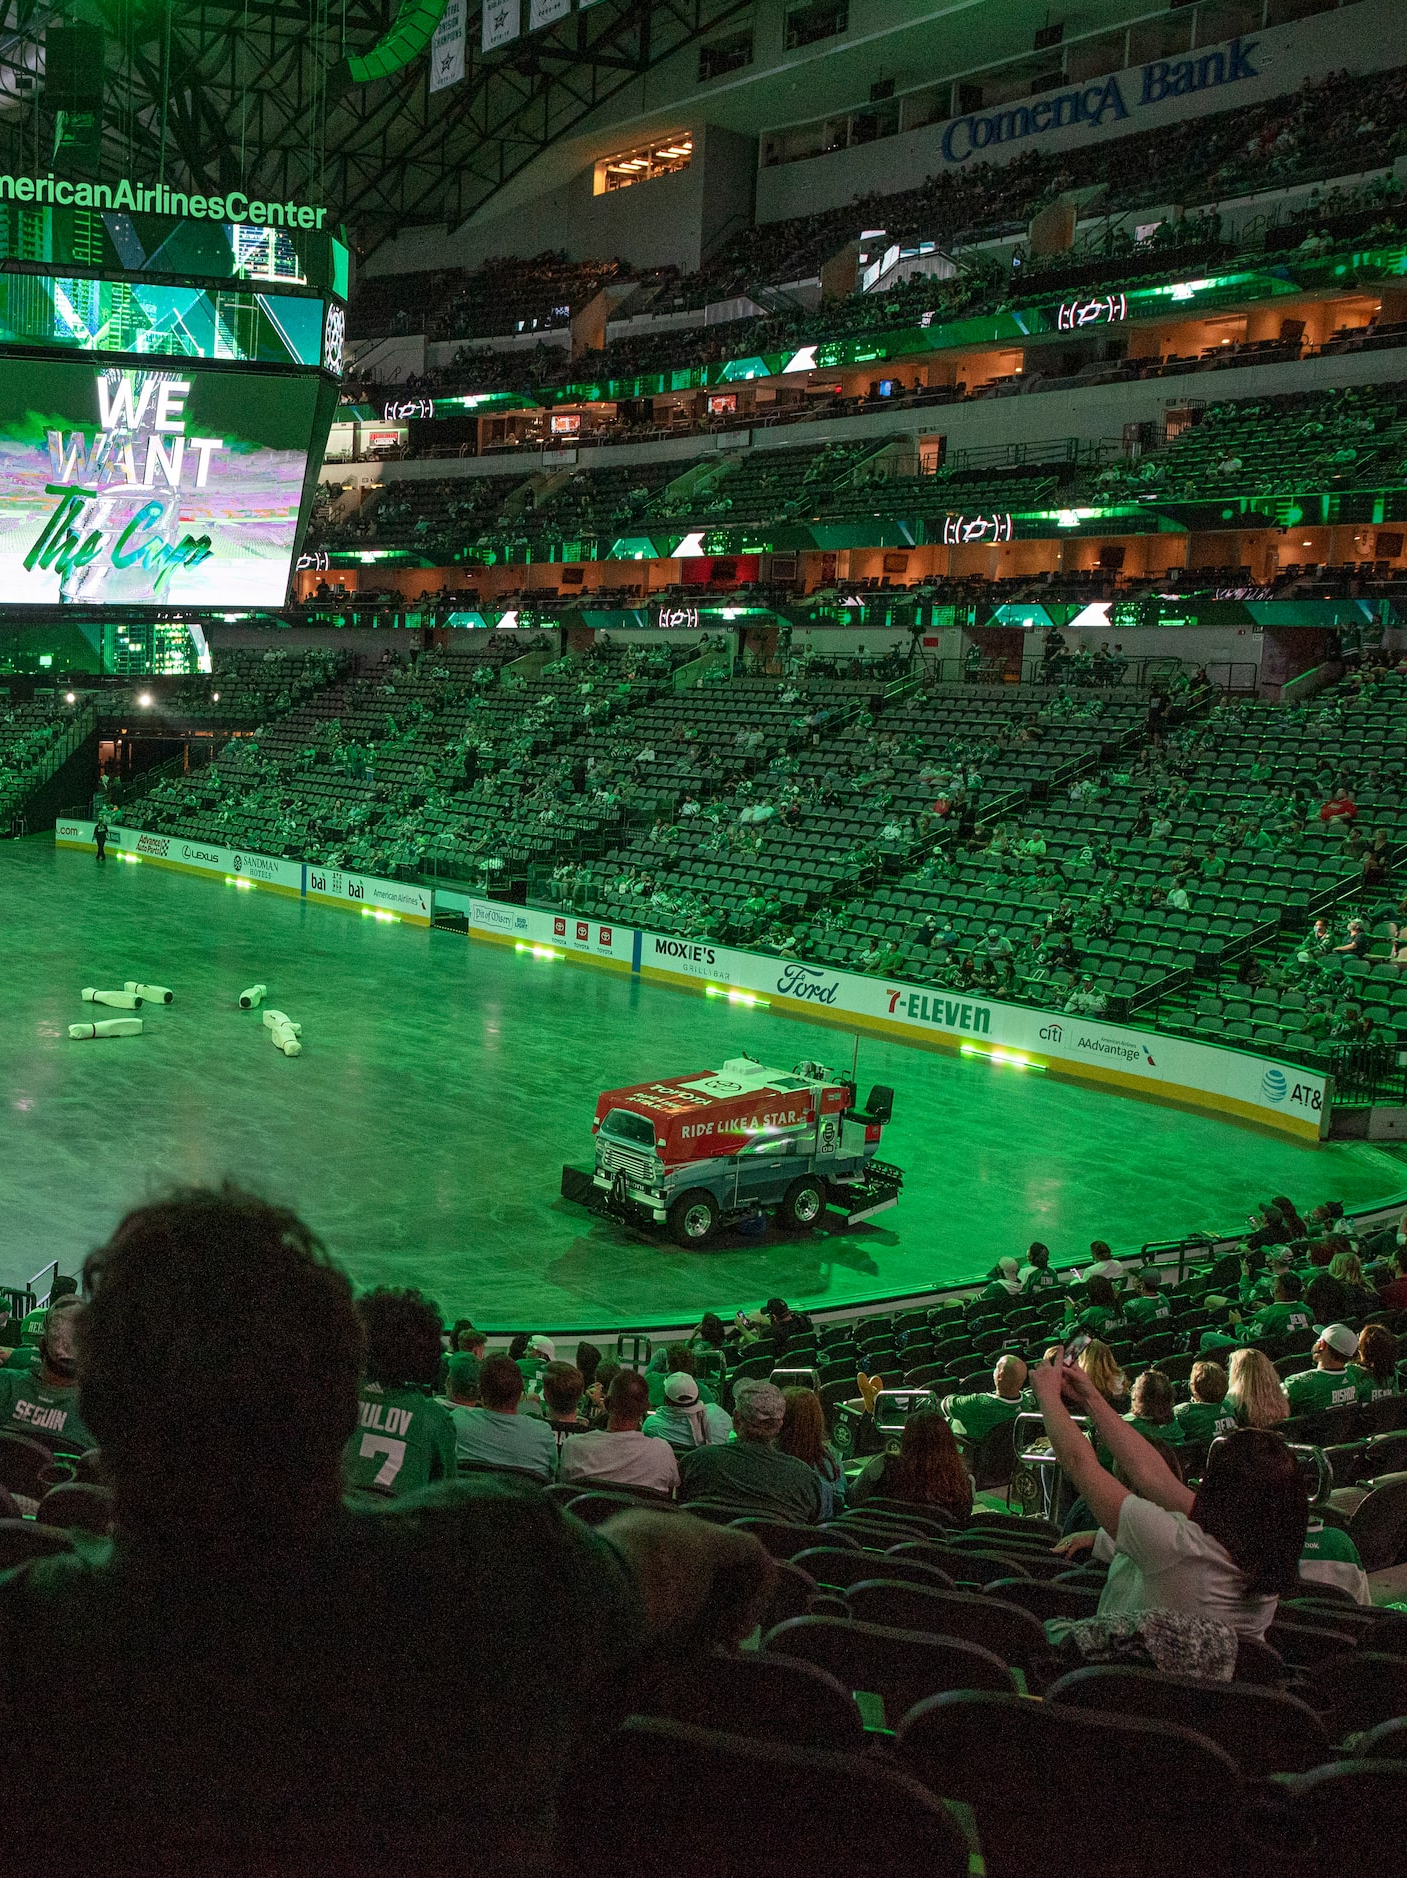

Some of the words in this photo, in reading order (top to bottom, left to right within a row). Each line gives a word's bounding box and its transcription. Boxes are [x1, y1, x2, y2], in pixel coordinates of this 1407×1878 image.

[1138, 37, 1261, 106] Bank
[97, 376, 191, 433] WE
[47, 430, 224, 488] WANT
[22, 483, 103, 574] The
[110, 500, 215, 595] Cup
[56, 826, 78, 836] .com
[191, 849, 219, 863] LEXUS
[244, 855, 279, 871] SANDMAN
[249, 869, 272, 879] HOTELS
[311, 872, 326, 891] bai
[348, 879, 364, 899] bai
[373, 889, 399, 901] American
[398, 893, 418, 906] Airlines
[574, 942, 590, 950] TOYOTA
[597, 947, 613, 955] TOYOTA
[655, 938, 715, 964] MOXIE'S
[776, 964, 840, 1005] Ford
[1039, 1024, 1063, 1043] citi
[1100, 1036, 1120, 1045] American
[1077, 1037, 1140, 1062] AAdvantage
[649, 1084, 713, 1106] TOYOTA
[681, 1122, 714, 1138] RIDE
[717, 1117, 747, 1134] LIKE
[749, 1116, 759, 1129] A
[1331, 1386, 1357, 1404] BISHOP
[12, 1399, 68, 1432] SEGUIN
[359, 1432, 407, 1487] 7
